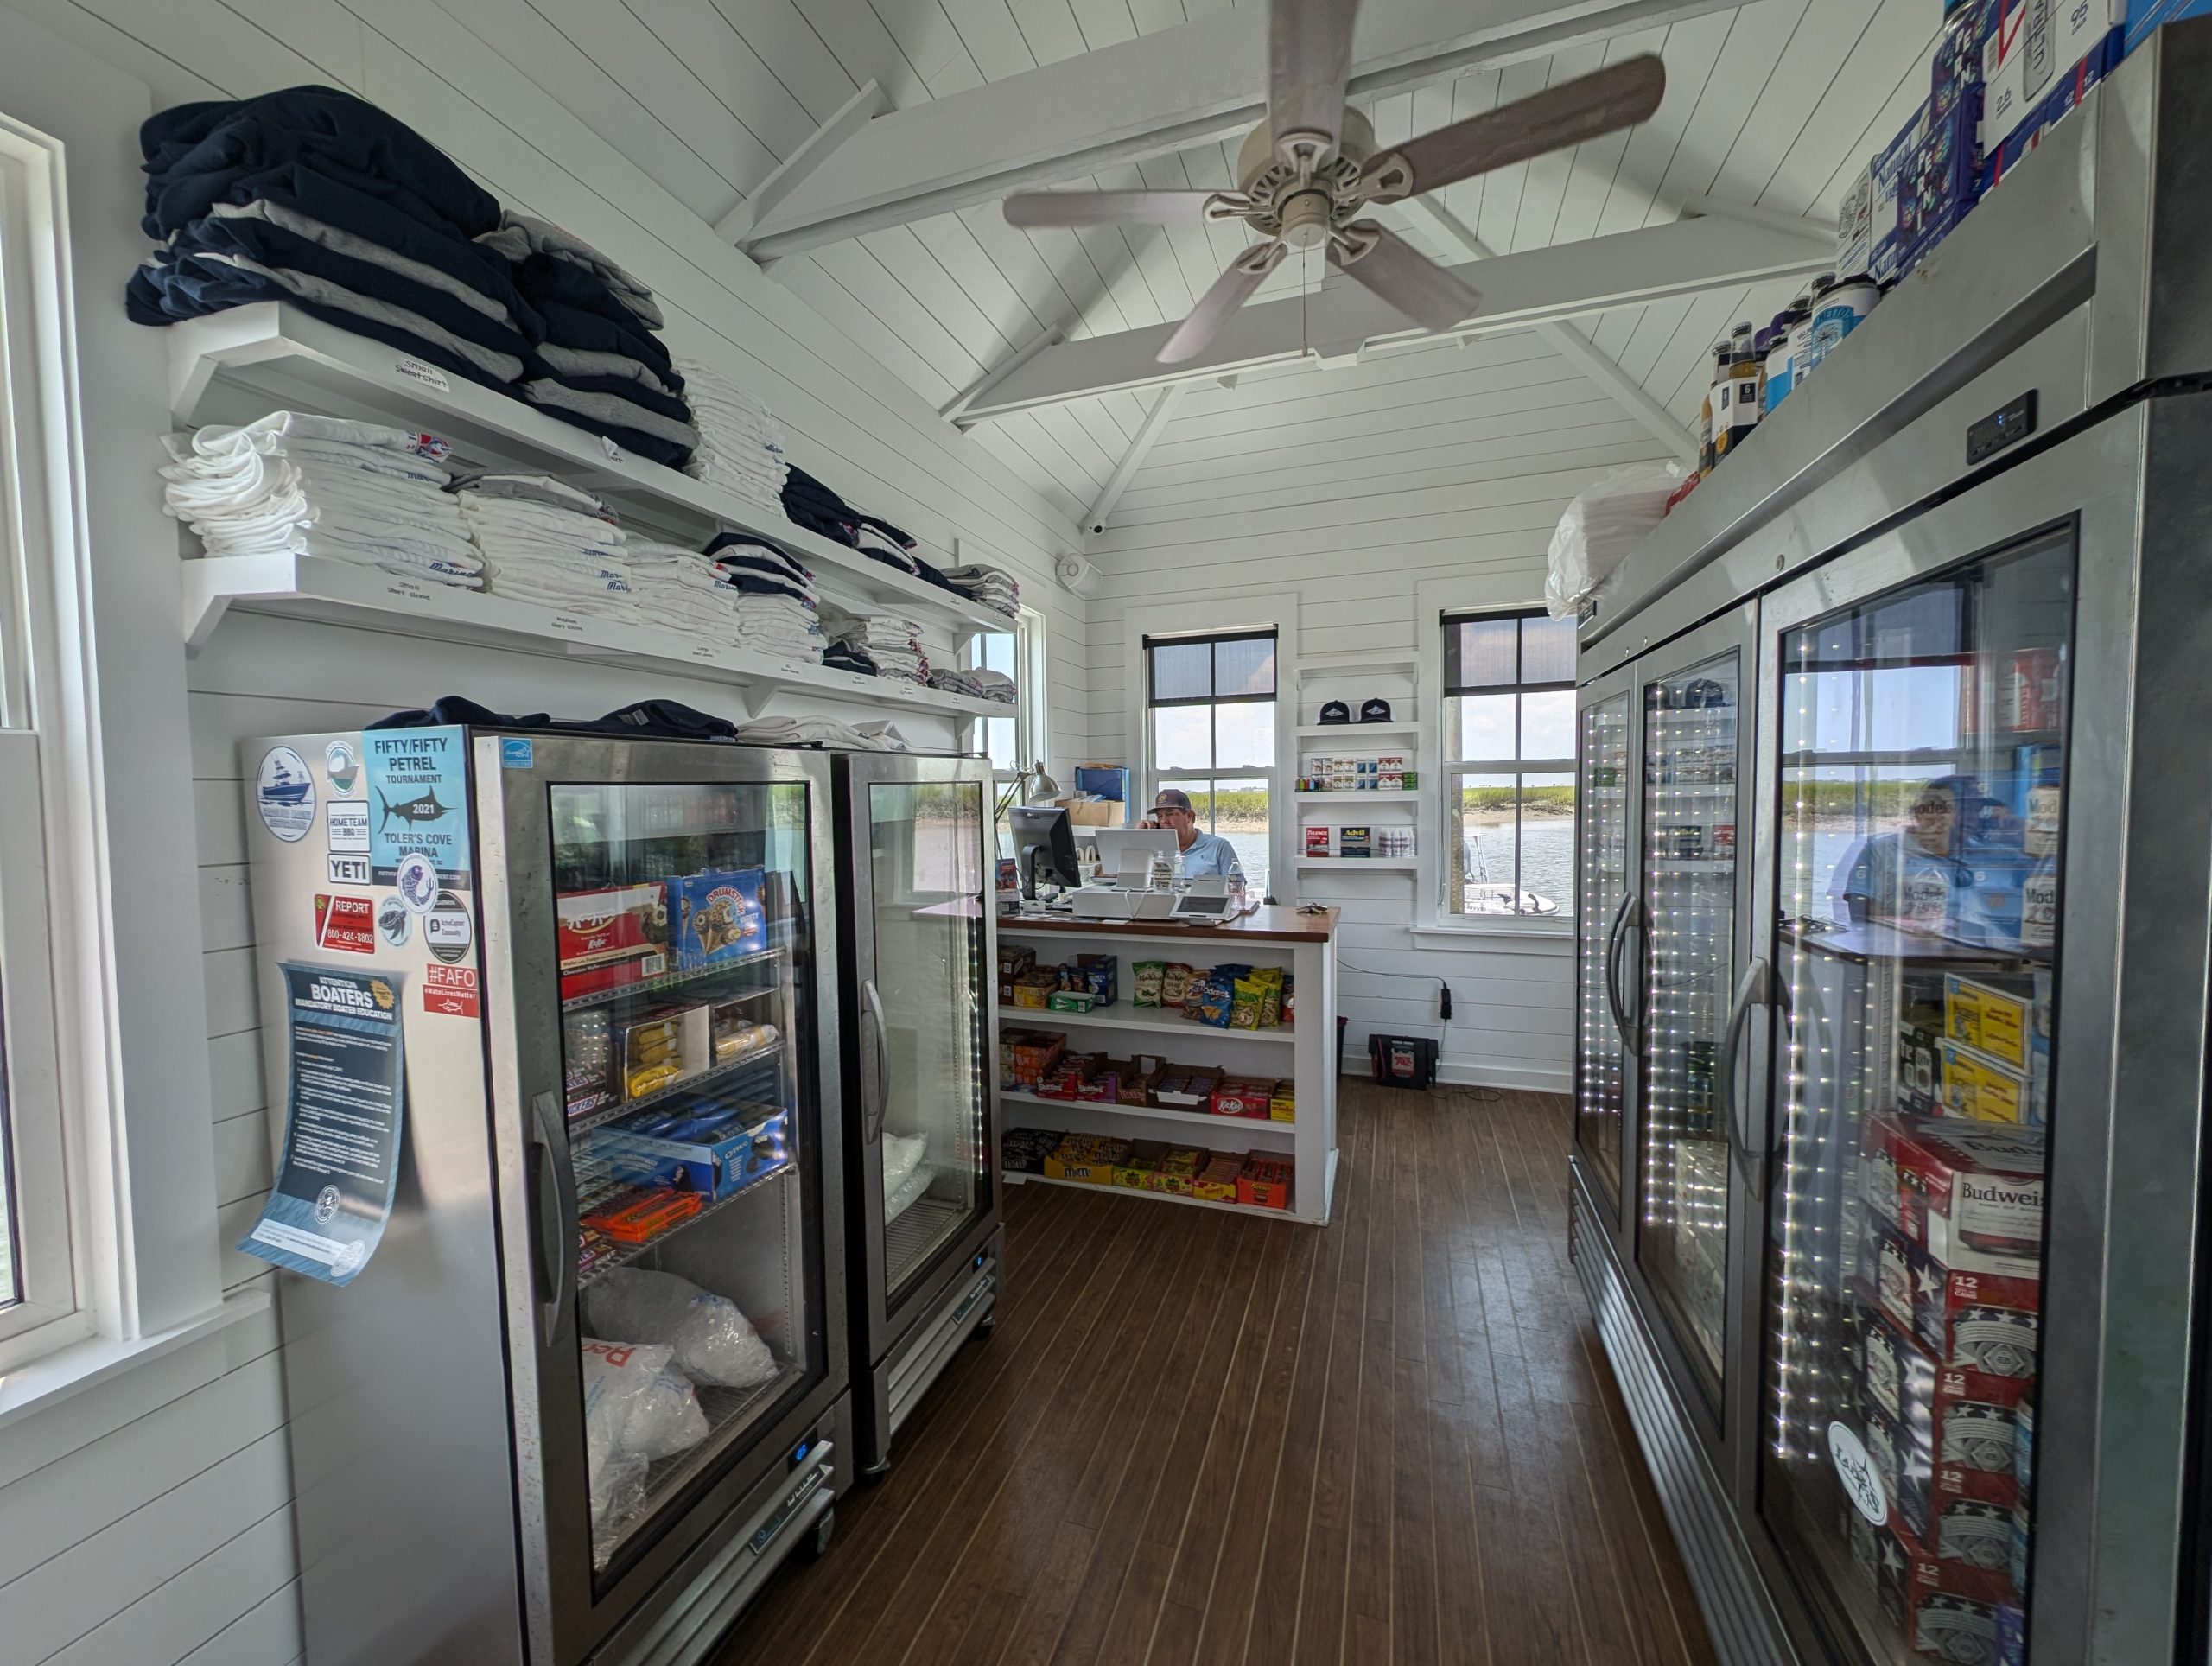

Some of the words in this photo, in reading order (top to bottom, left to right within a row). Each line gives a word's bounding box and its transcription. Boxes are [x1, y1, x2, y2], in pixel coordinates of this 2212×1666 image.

[2071, 0, 2088, 26] 95
[405, 360, 433, 374] Small
[1745, 384, 1751, 394] 6
[374, 737, 448, 754] FIFTY/FIFTY
[390, 757, 436, 771] PETREL
[386, 774, 442, 784] TOURNAMENT
[412, 804, 435, 814] 2021
[2029, 799, 2058, 814] Mod
[385, 833, 423, 844] TOLER'S
[426, 835, 452, 845] COVE
[331, 860, 366, 880] YETI
[707, 887, 746, 915] DRUMSTICK
[2026, 888, 2056, 905] Mod
[335, 900, 370, 914] REPORT
[319, 976, 358, 989] ATTENTION
[429, 966, 475, 987] #FAFO
[310, 983, 373, 1008] BOATERS
[295, 998, 333, 1010] MANDATORY
[333, 1004, 357, 1014] BOATER
[357, 1008, 393, 1021] EDUCATION
[1962, 1182, 2043, 1206] Budwei
[1955, 1275, 1979, 1288] 12
[1943, 1372, 1966, 1384] 12
[1941, 1470, 1964, 1482] 12
[1917, 1562, 1940, 1577] 12
